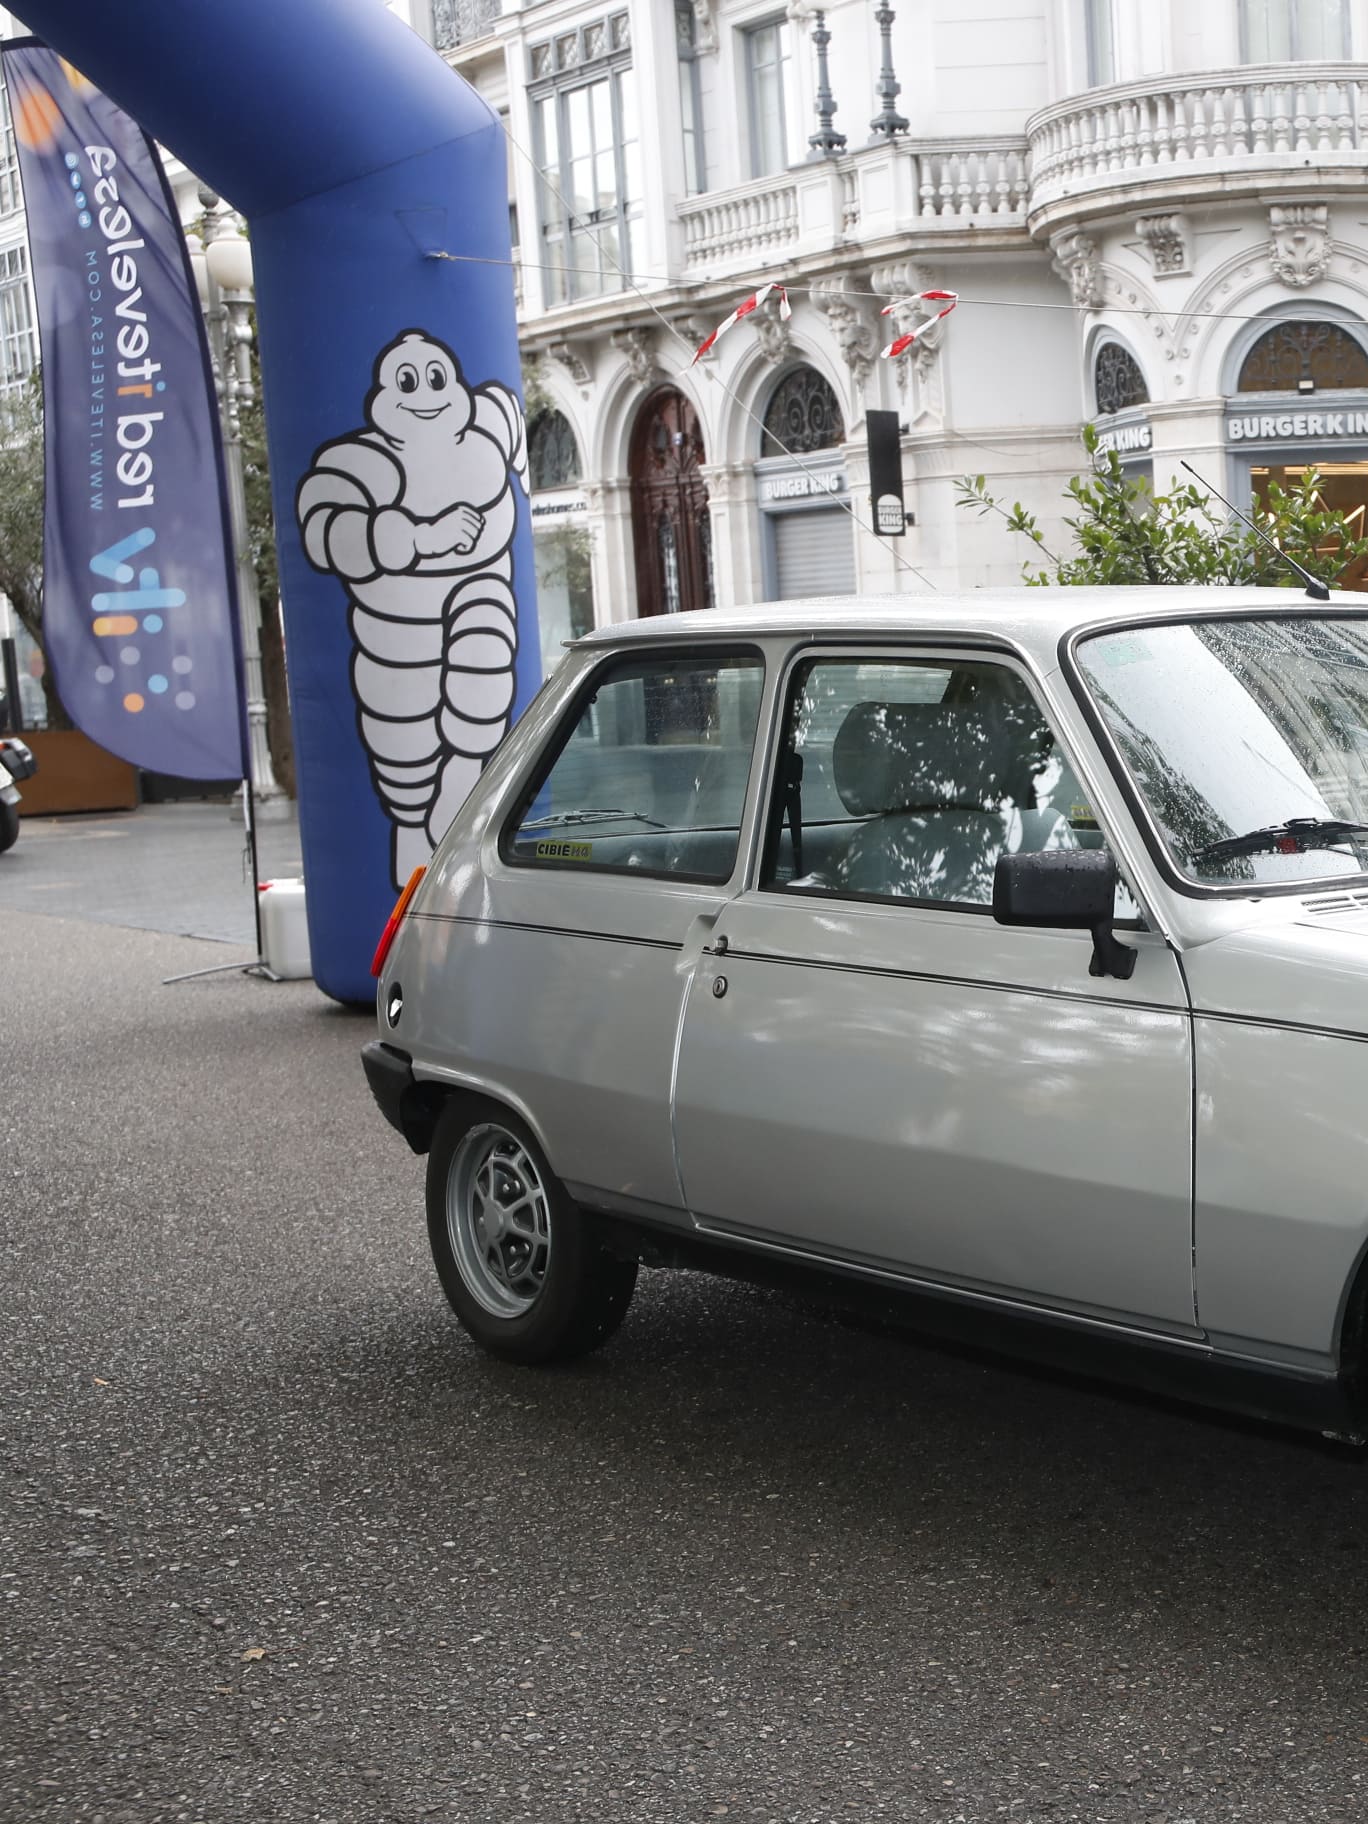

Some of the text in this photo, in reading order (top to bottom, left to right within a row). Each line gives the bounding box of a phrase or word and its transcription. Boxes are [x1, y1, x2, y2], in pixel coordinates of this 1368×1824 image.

[1115, 426, 1151, 451] KING
[1228, 414, 1324, 440] BURGER
[765, 472, 839, 499] BURGER KING
[879, 514, 903, 526] KING
[537, 843, 571, 857] CIBIE
